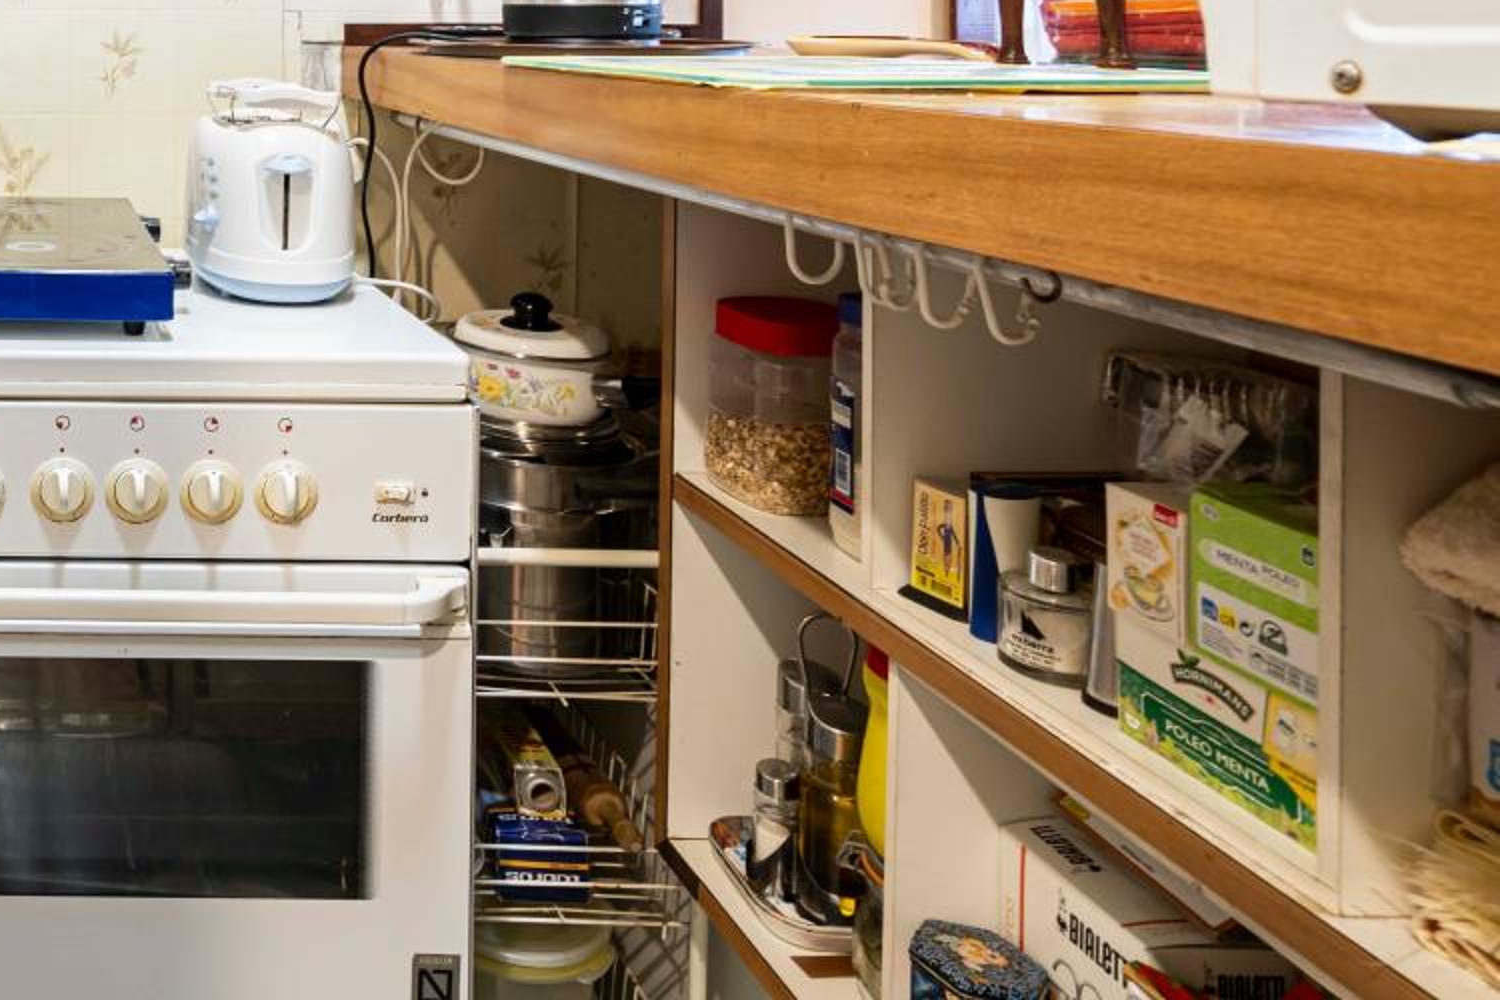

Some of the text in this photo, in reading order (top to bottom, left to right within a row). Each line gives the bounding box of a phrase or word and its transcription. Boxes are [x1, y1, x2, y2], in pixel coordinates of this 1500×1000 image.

[1215, 549, 1301, 588] MENTA POLEO
[1175, 666, 1250, 718] HORNIMANS
[1164, 718, 1271, 793] POLEO MENTA
